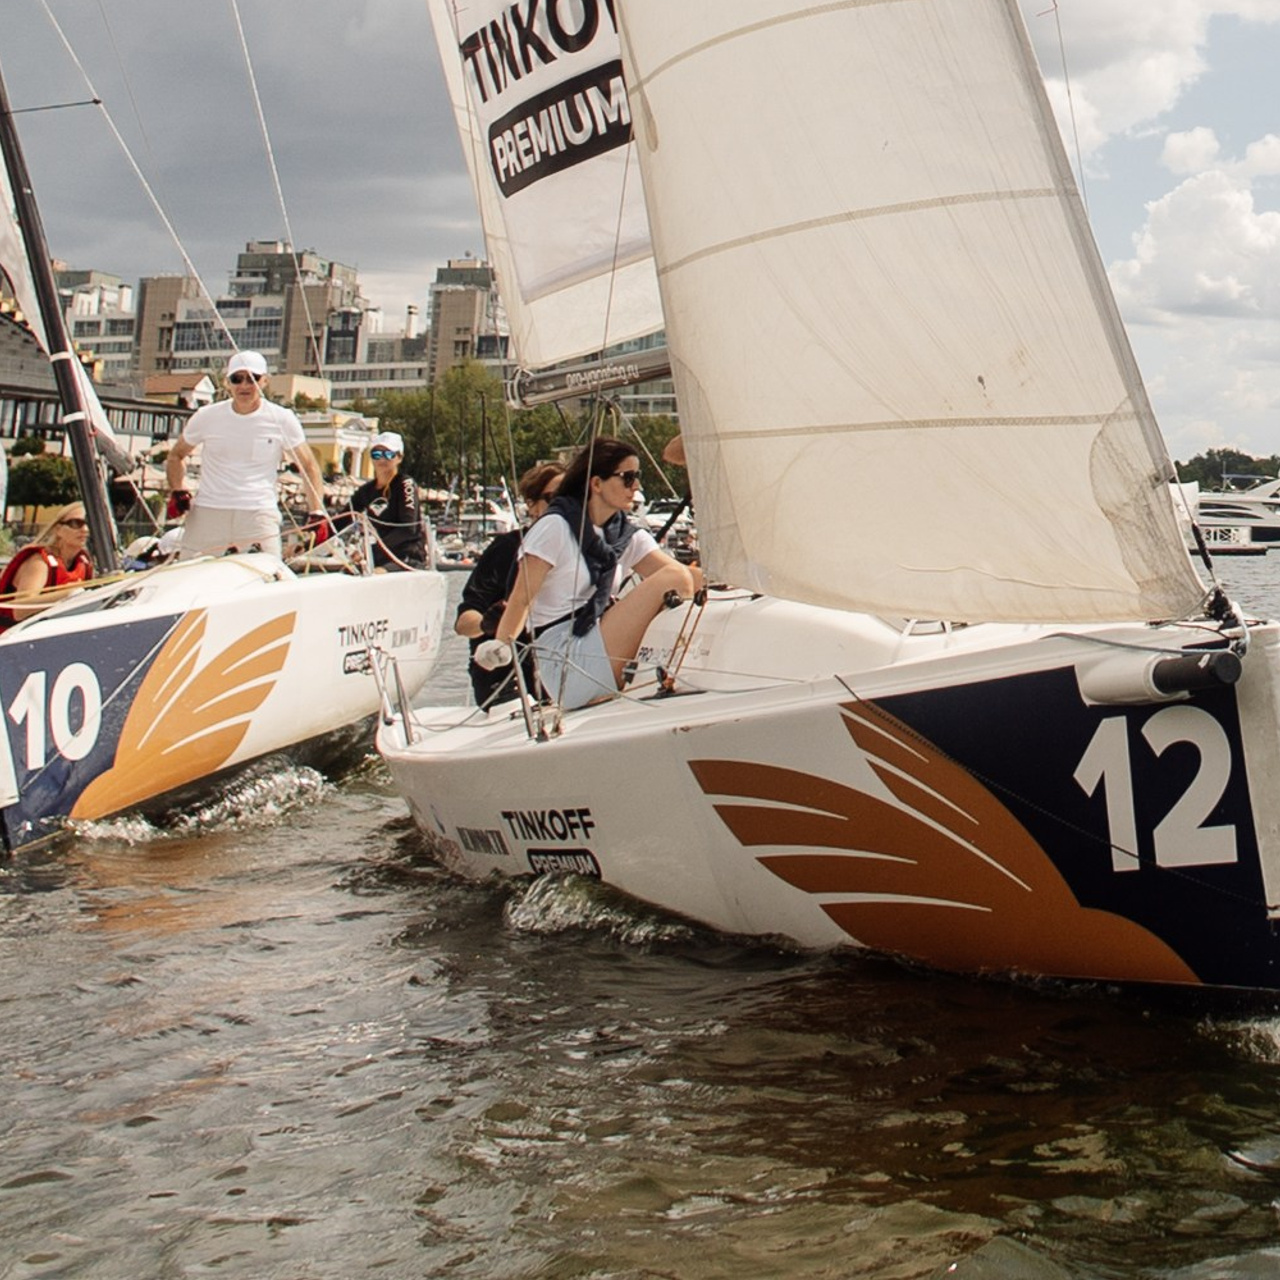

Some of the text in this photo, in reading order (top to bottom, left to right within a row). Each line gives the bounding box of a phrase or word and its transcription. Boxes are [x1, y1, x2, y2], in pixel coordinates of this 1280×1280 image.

[492, 75, 632, 183] PREMIUM
[402, 478, 415, 510] ROXY
[338, 618, 389, 647] TINKOFF
[8, 661, 102, 771] 10
[501, 807, 595, 841] TINKOFF
[1073, 705, 1238, 872] 12
